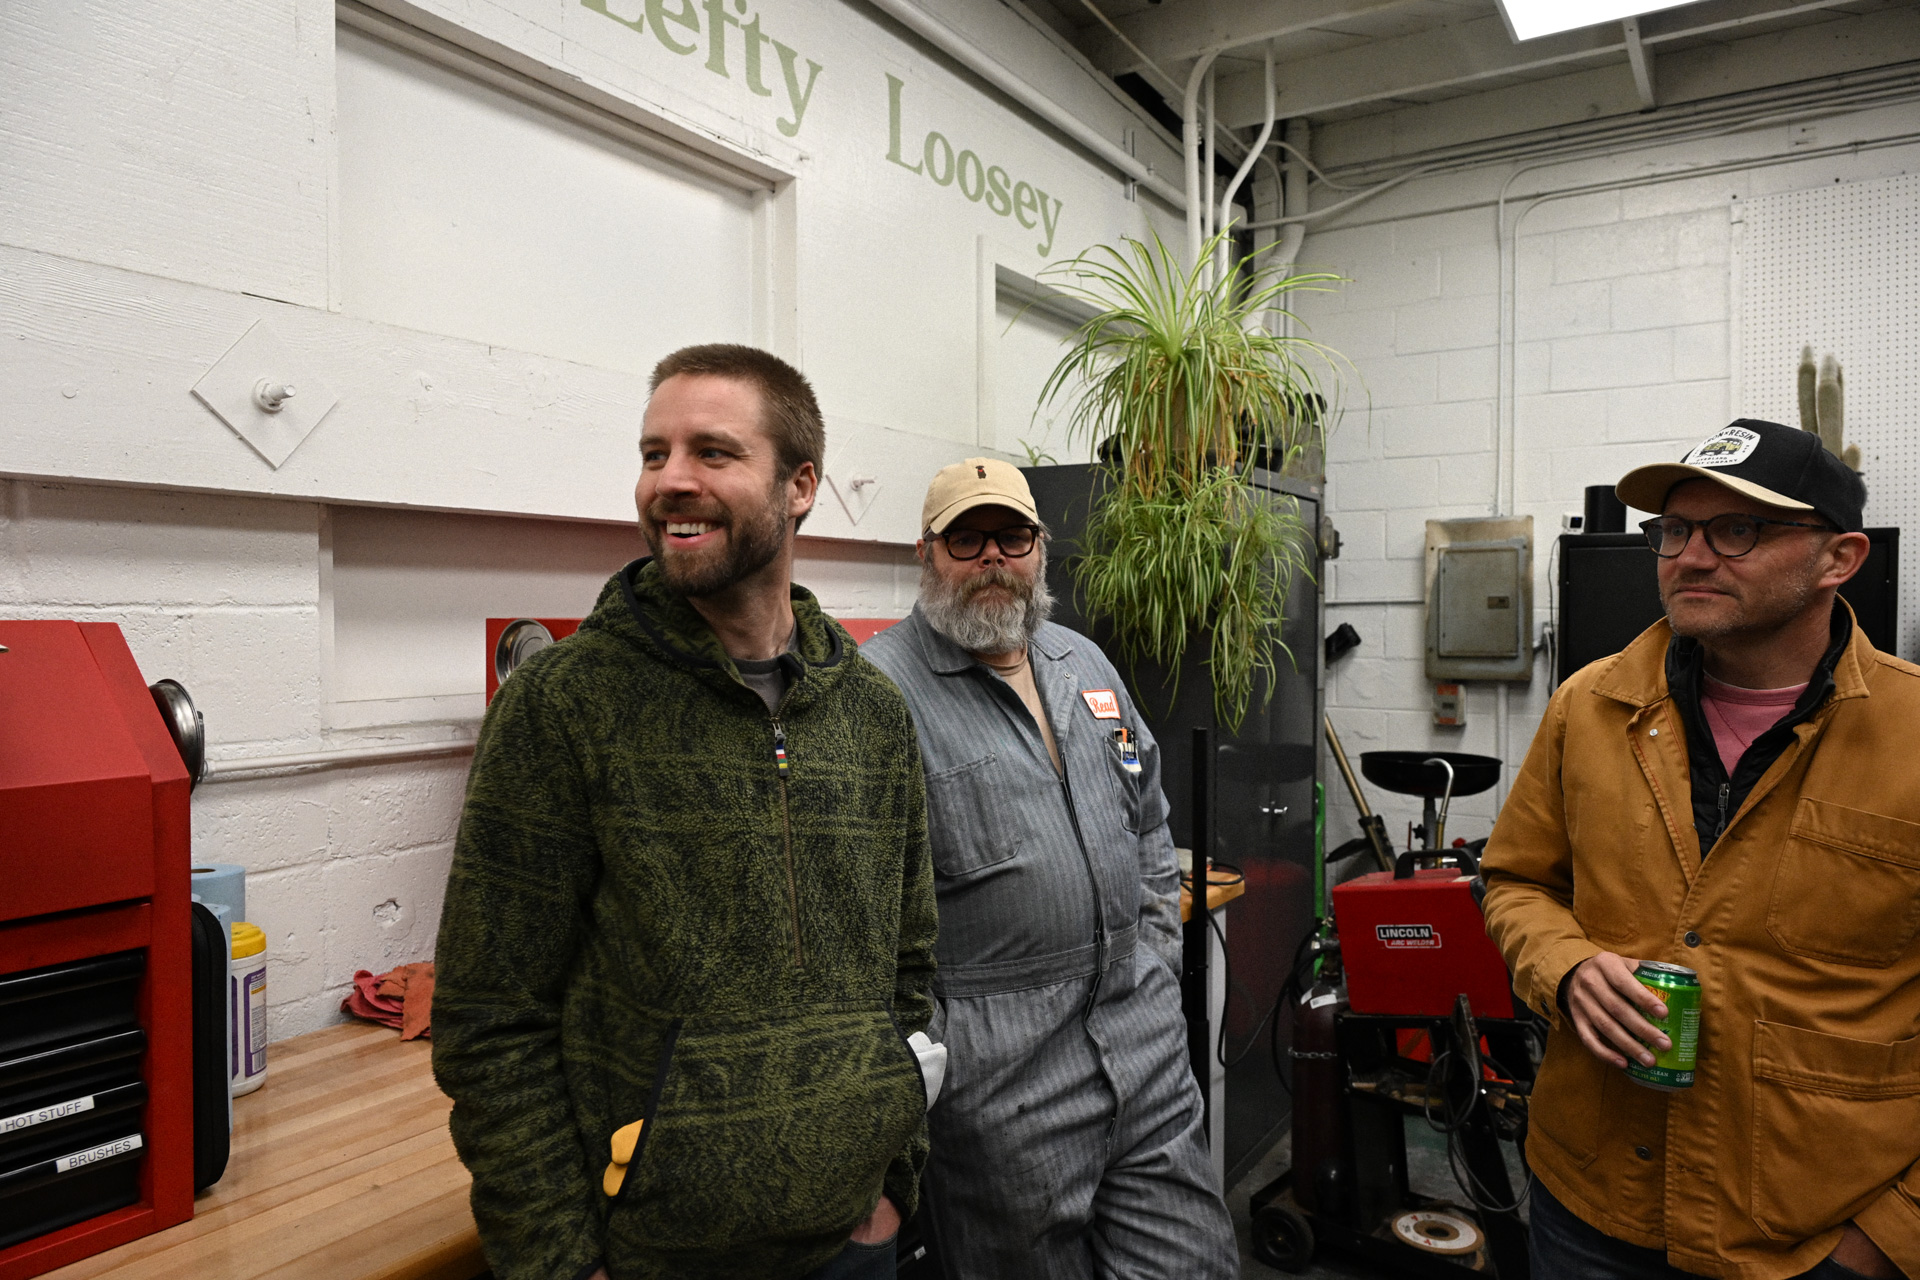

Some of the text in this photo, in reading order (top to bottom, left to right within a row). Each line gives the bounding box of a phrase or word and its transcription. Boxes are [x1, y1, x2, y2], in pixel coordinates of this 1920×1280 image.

[580, 0, 1064, 258] efty Loosey
[1728, 429, 1756, 441] RESIN
[1089, 696, 1116, 714] Read
[1379, 928, 1430, 938] LINCOLN
[1641, 970, 1664, 980] ORIGINA
[5, 1114, 35, 1131] HOT
[39, 1101, 82, 1122] STUFF
[69, 1140, 131, 1168] BRUSHES
